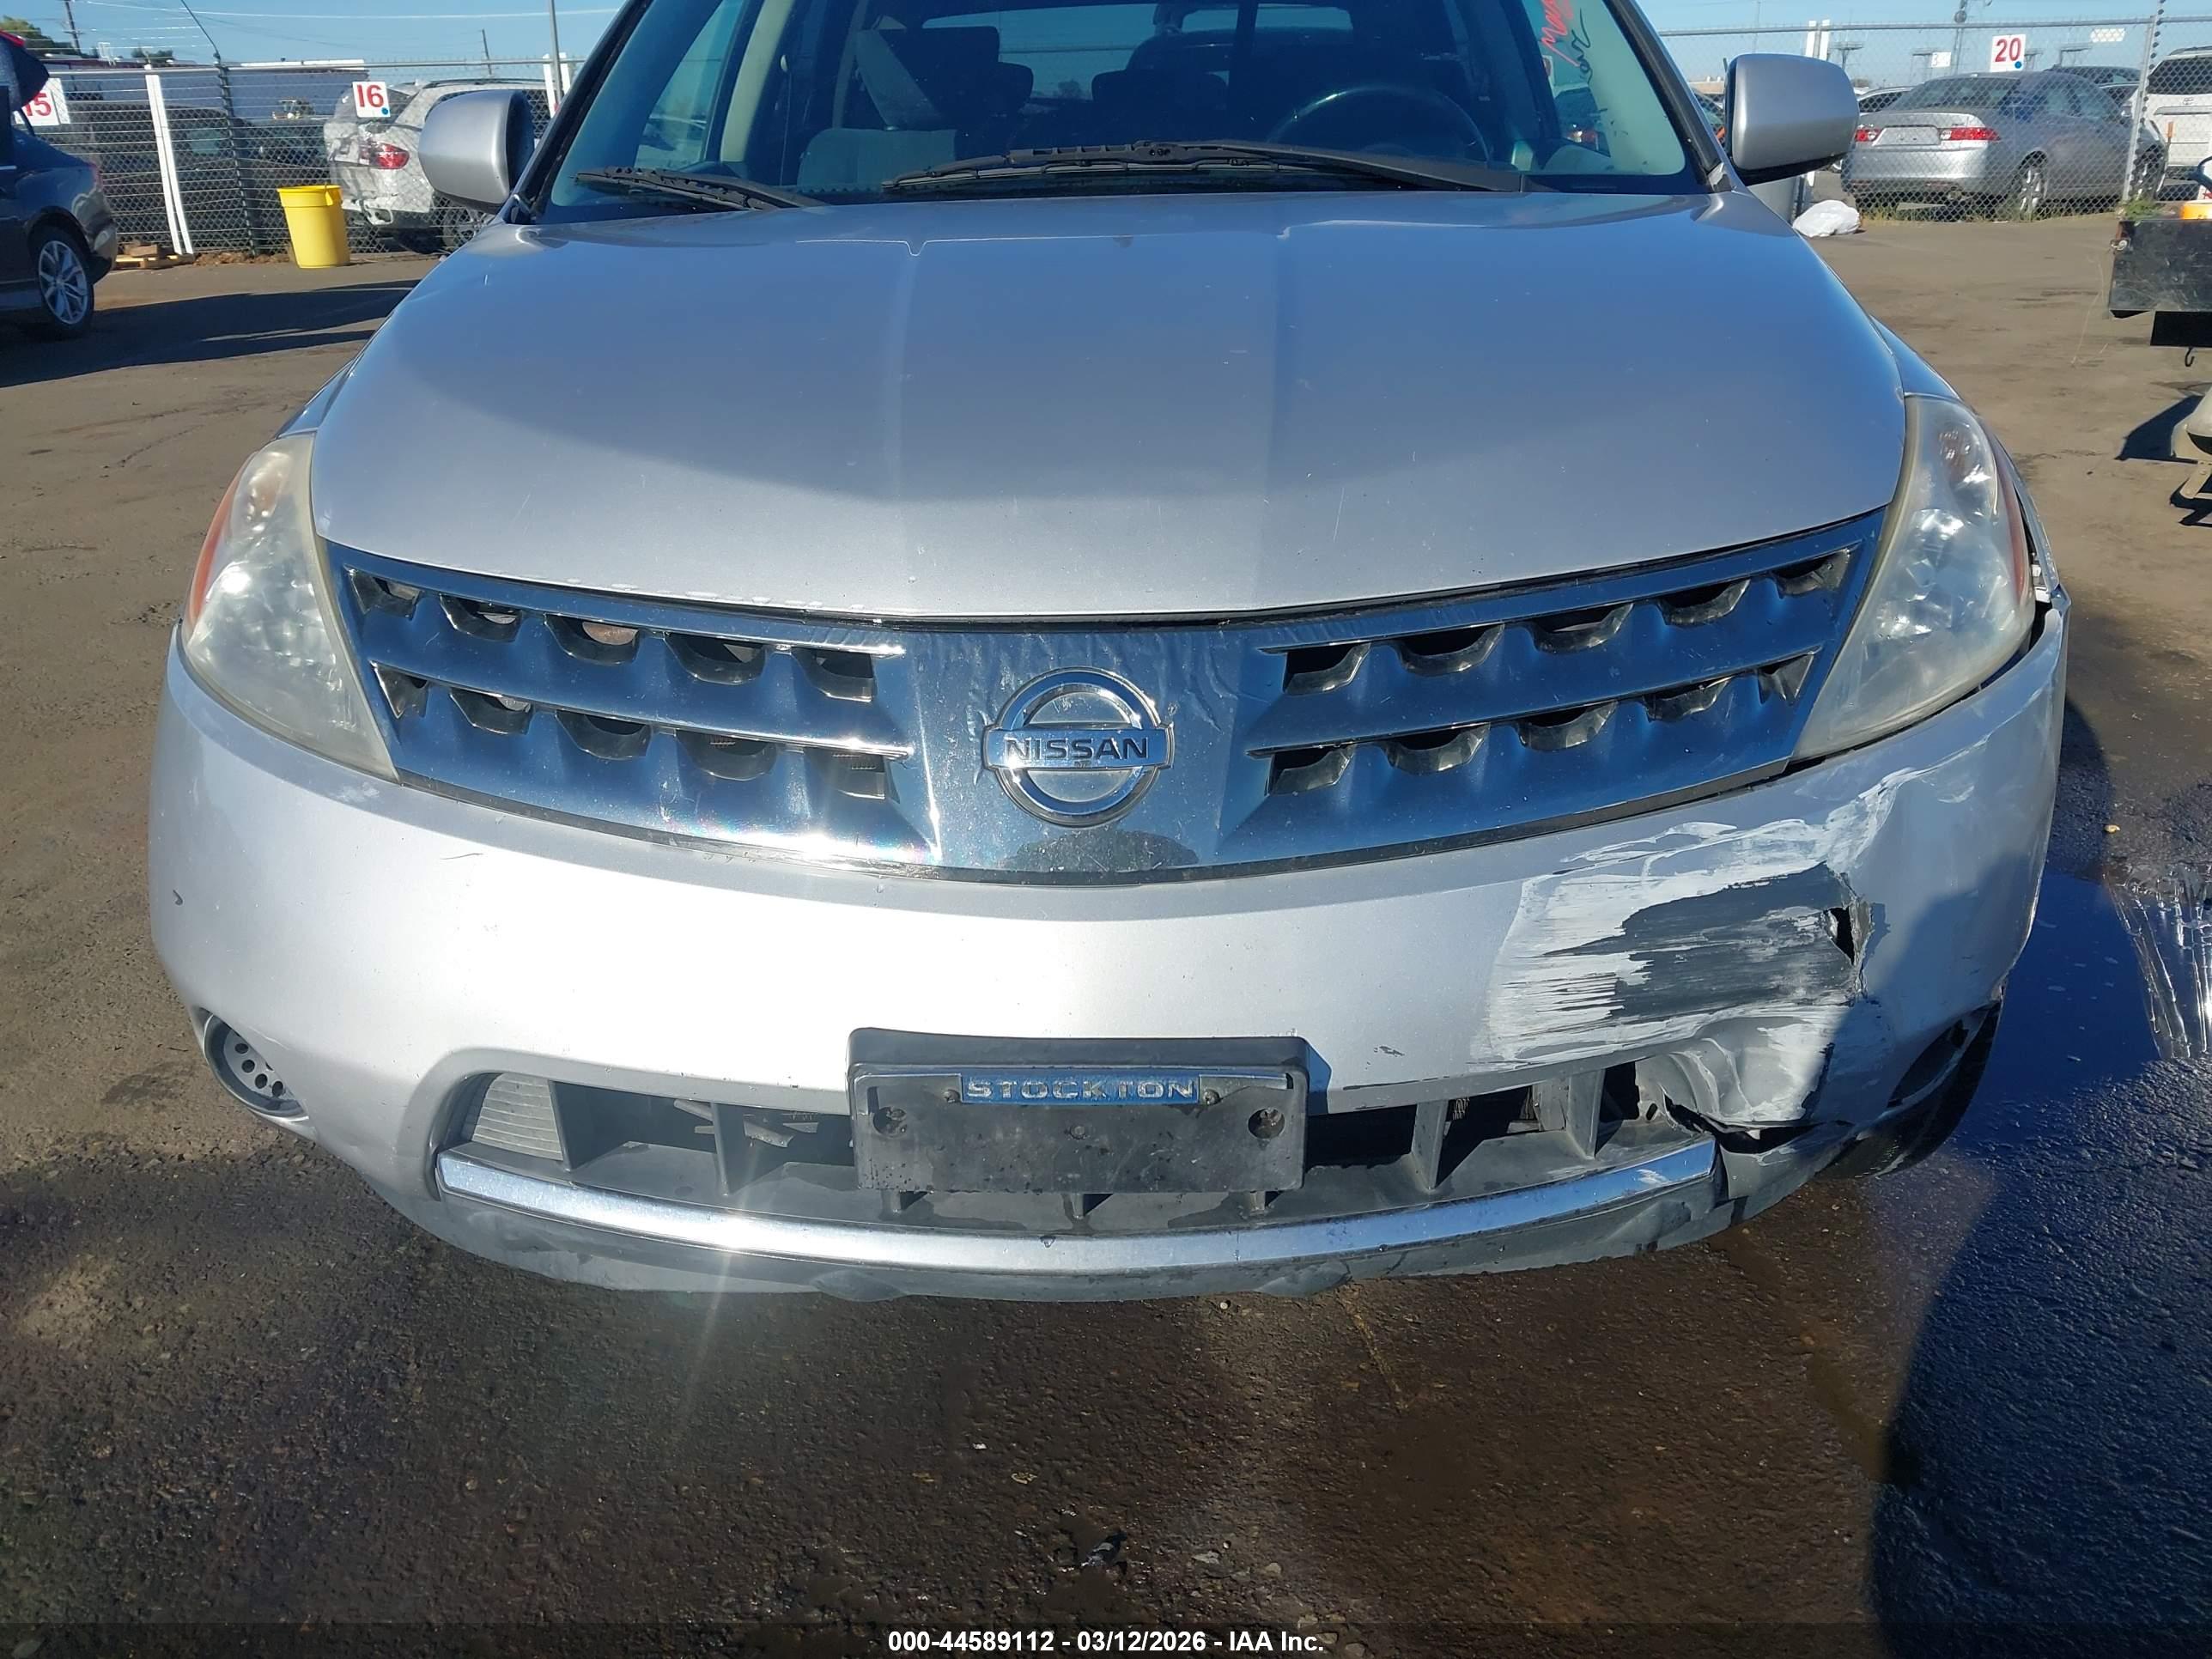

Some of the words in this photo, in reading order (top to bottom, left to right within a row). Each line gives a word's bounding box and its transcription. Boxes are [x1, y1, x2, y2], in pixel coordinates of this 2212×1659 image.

[1995, 38, 2021, 62] 20
[357, 84, 384, 107] 16
[1005, 737, 1148, 760] NISSAN
[967, 1080, 1194, 1099] STOCKTON
